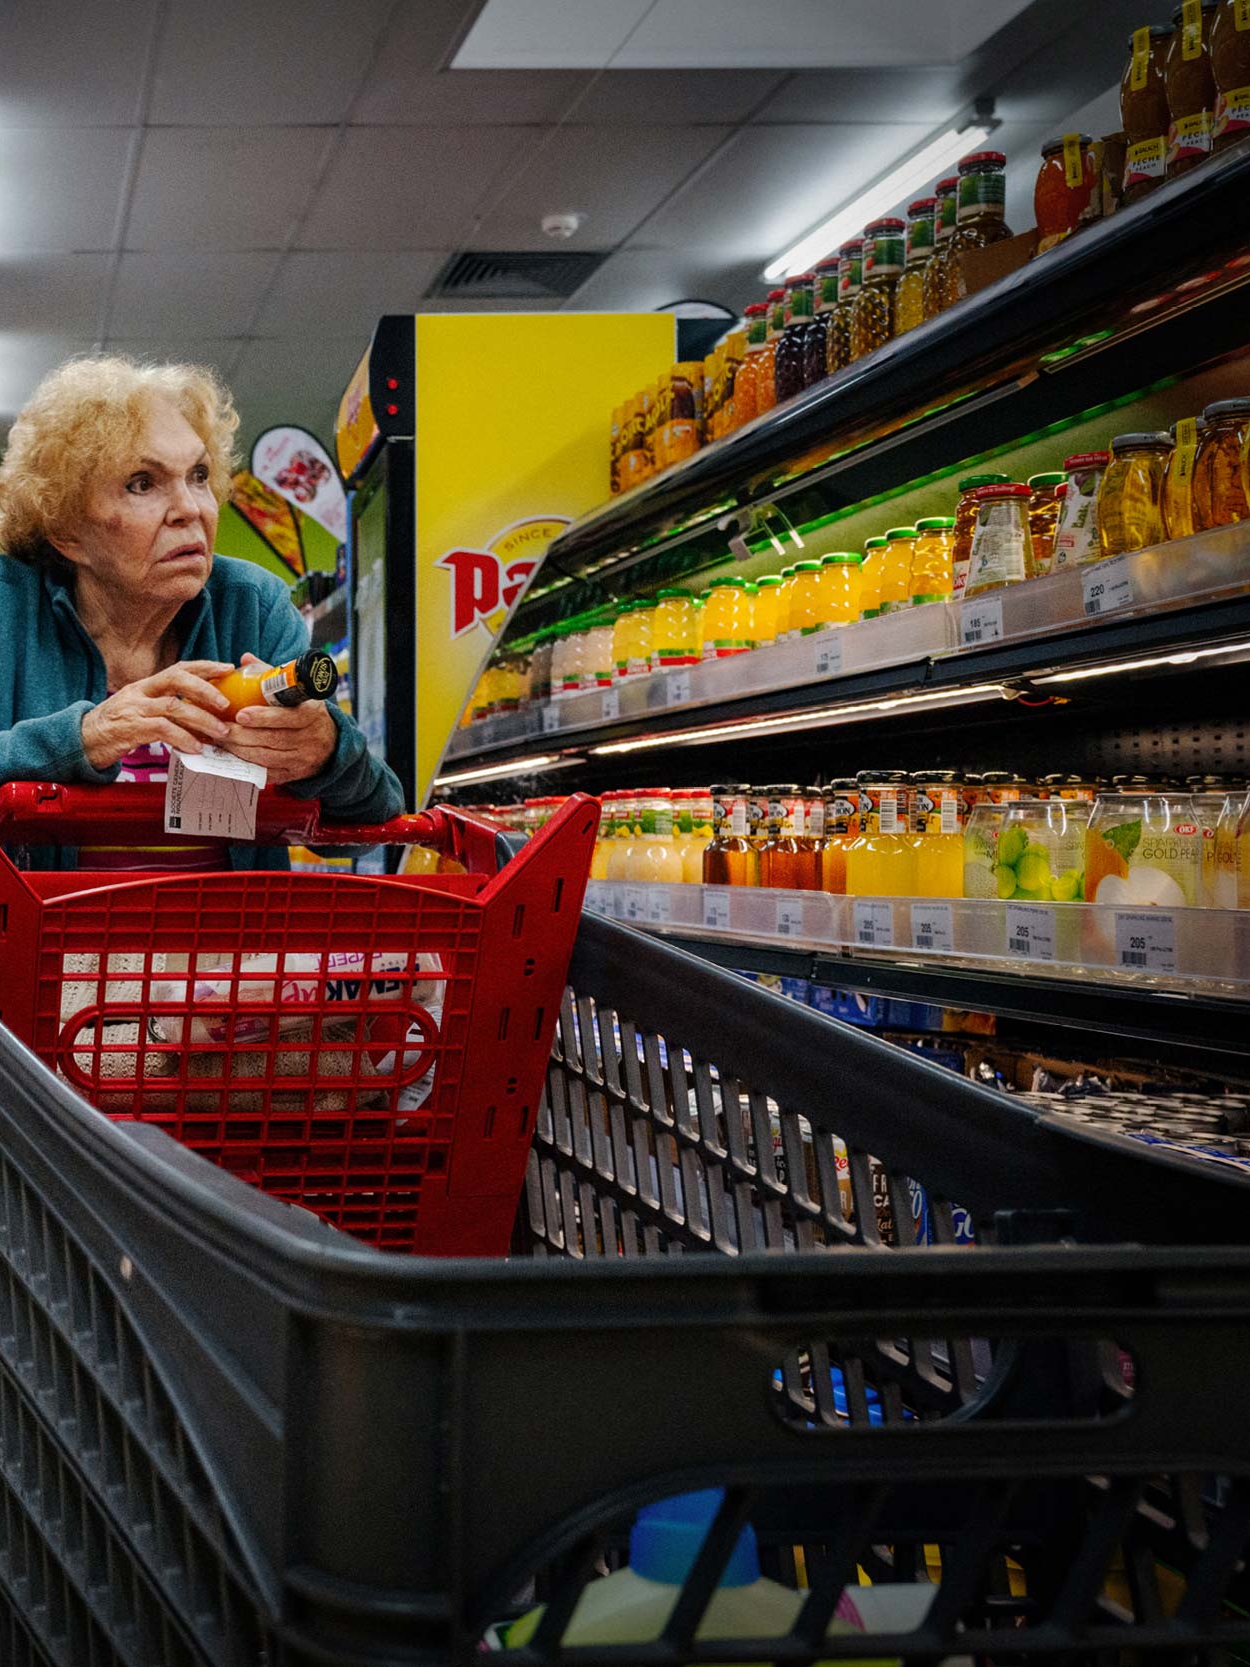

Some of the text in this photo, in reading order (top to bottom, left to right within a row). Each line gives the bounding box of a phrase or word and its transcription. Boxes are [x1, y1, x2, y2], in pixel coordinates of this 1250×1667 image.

[504, 528, 553, 551] SINCE
[1090, 584, 1105, 598] 220
[1142, 847, 1178, 860] GOLD
[1016, 925, 1030, 938] 205
[1130, 936, 1146, 949] 205
